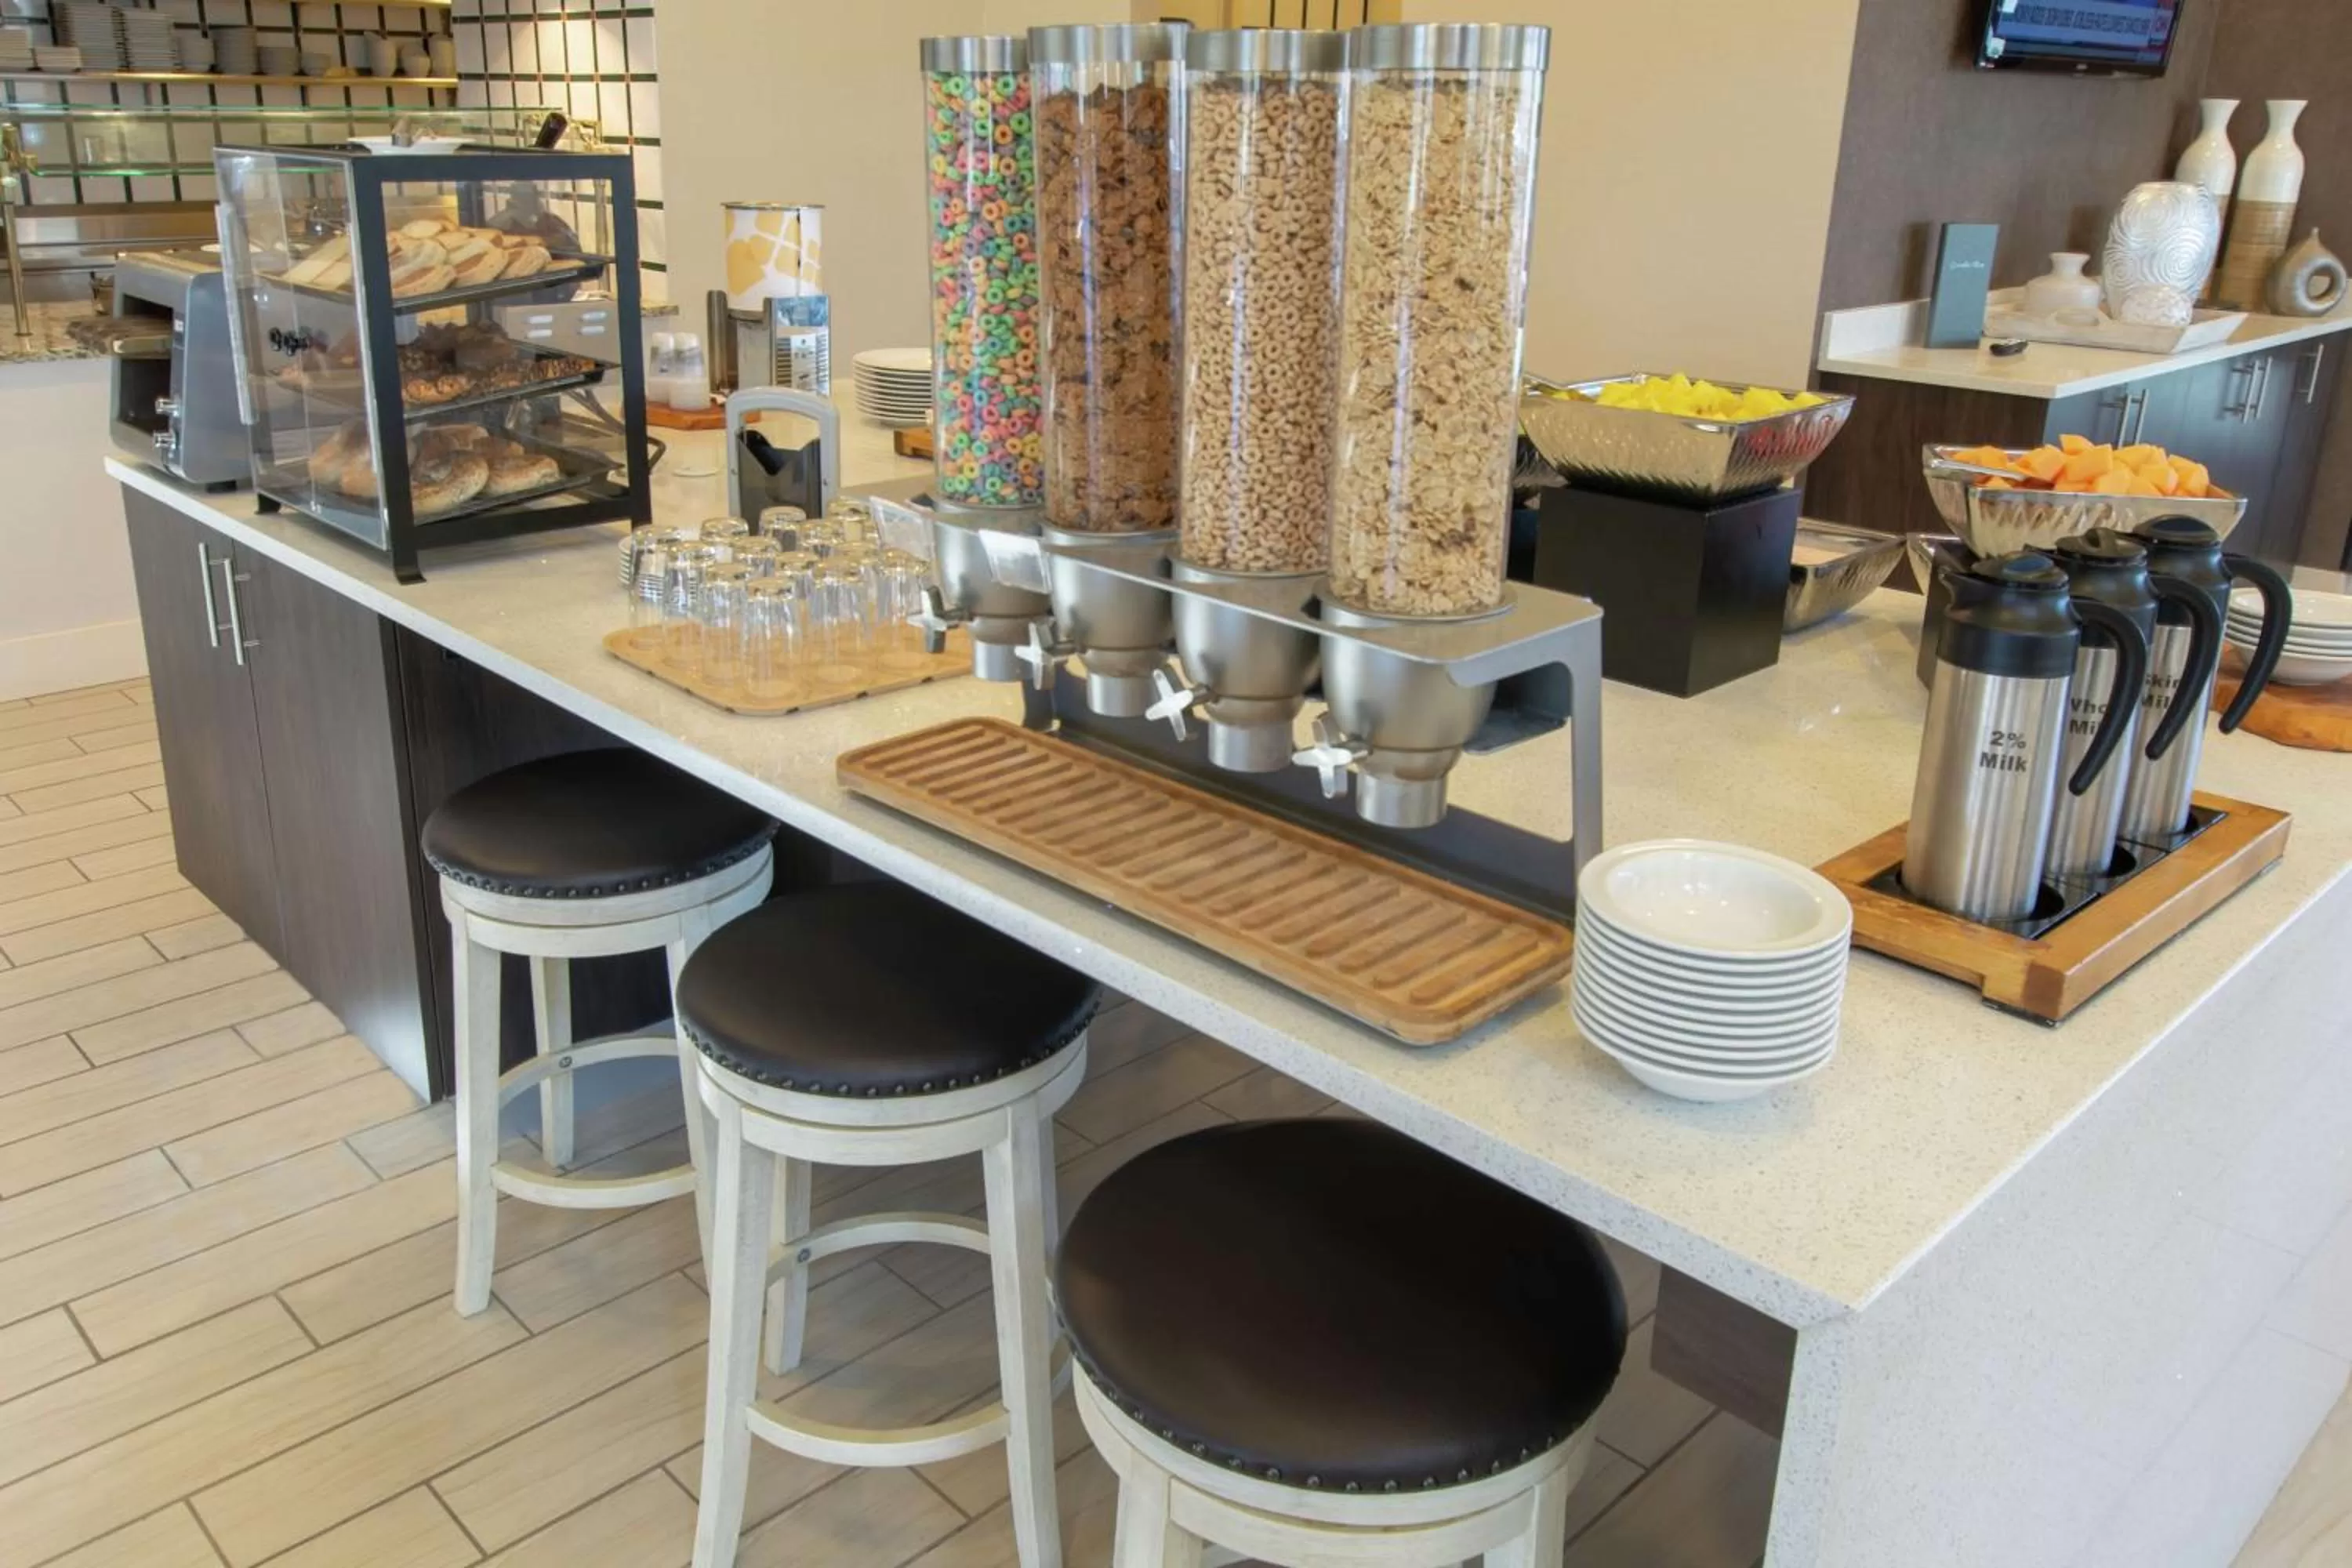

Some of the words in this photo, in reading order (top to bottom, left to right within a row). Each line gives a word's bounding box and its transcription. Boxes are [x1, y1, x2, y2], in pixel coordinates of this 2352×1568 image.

[2141, 695, 2171, 709] Mil
[2069, 720, 2097, 735] Mi
[1990, 731, 2027, 749] 2%
[1979, 751, 2027, 772] Milk
